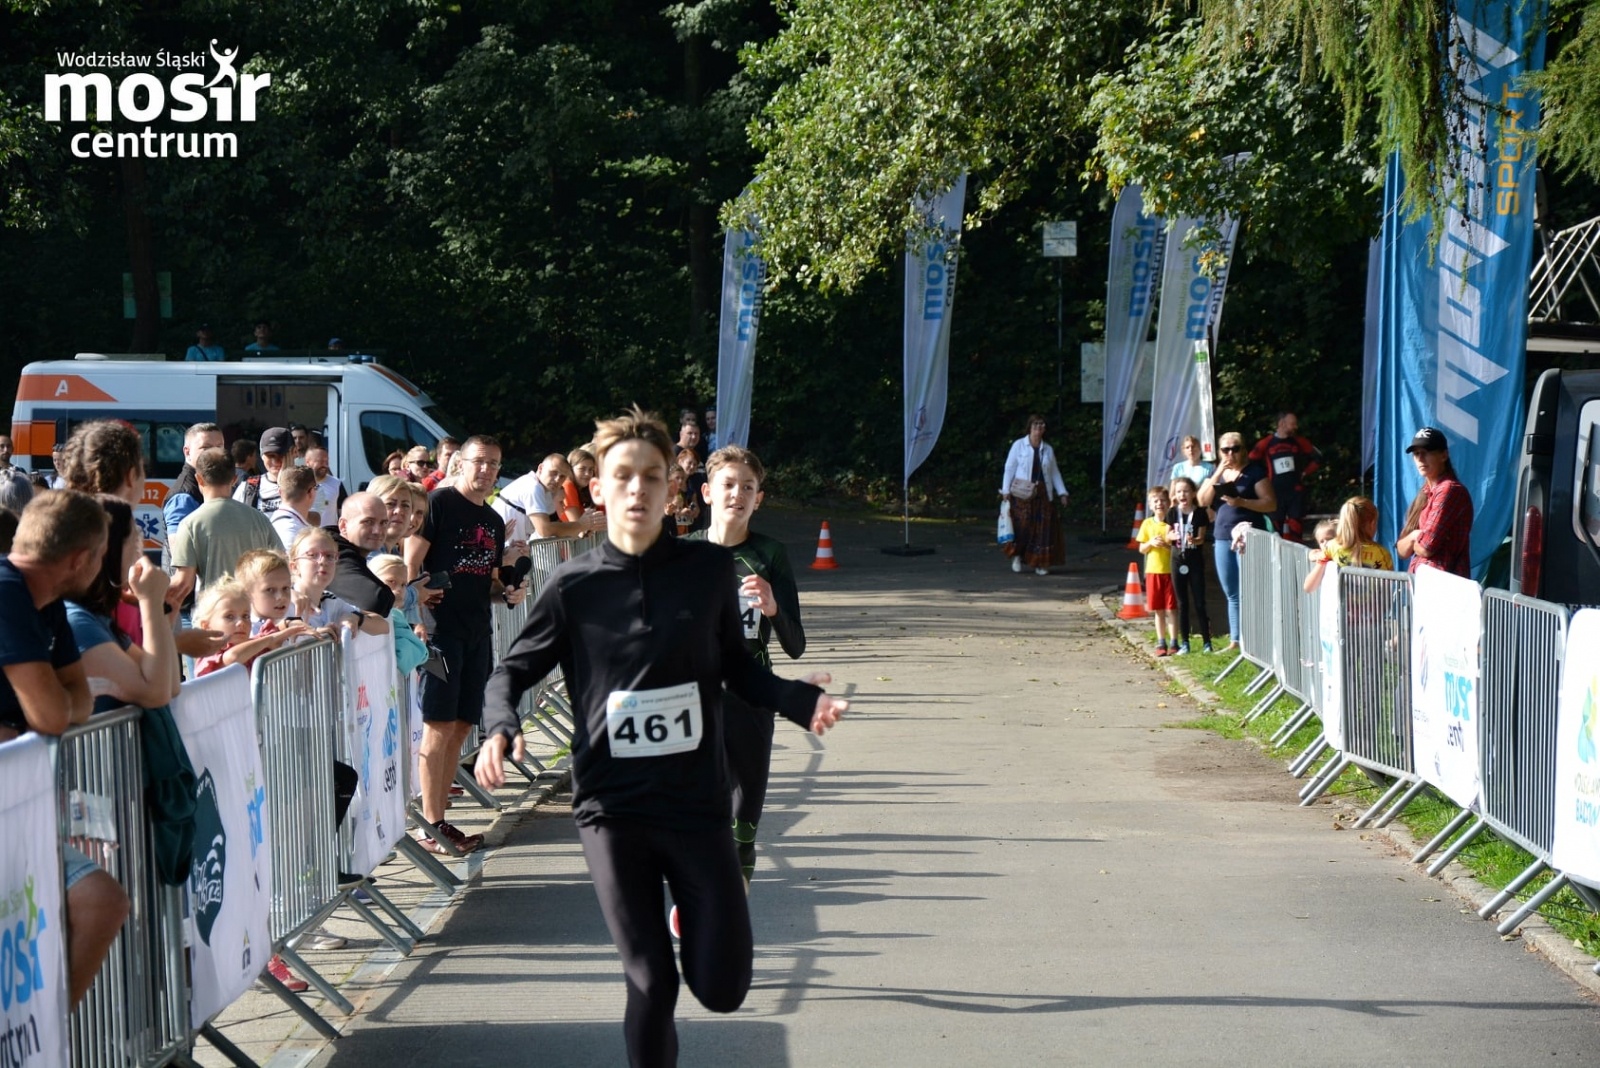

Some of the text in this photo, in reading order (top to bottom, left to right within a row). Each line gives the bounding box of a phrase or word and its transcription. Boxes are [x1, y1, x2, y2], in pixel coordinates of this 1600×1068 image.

[1497, 83, 1524, 215] SPORT
[55, 379, 69, 397] A
[613, 708, 692, 745] 461
